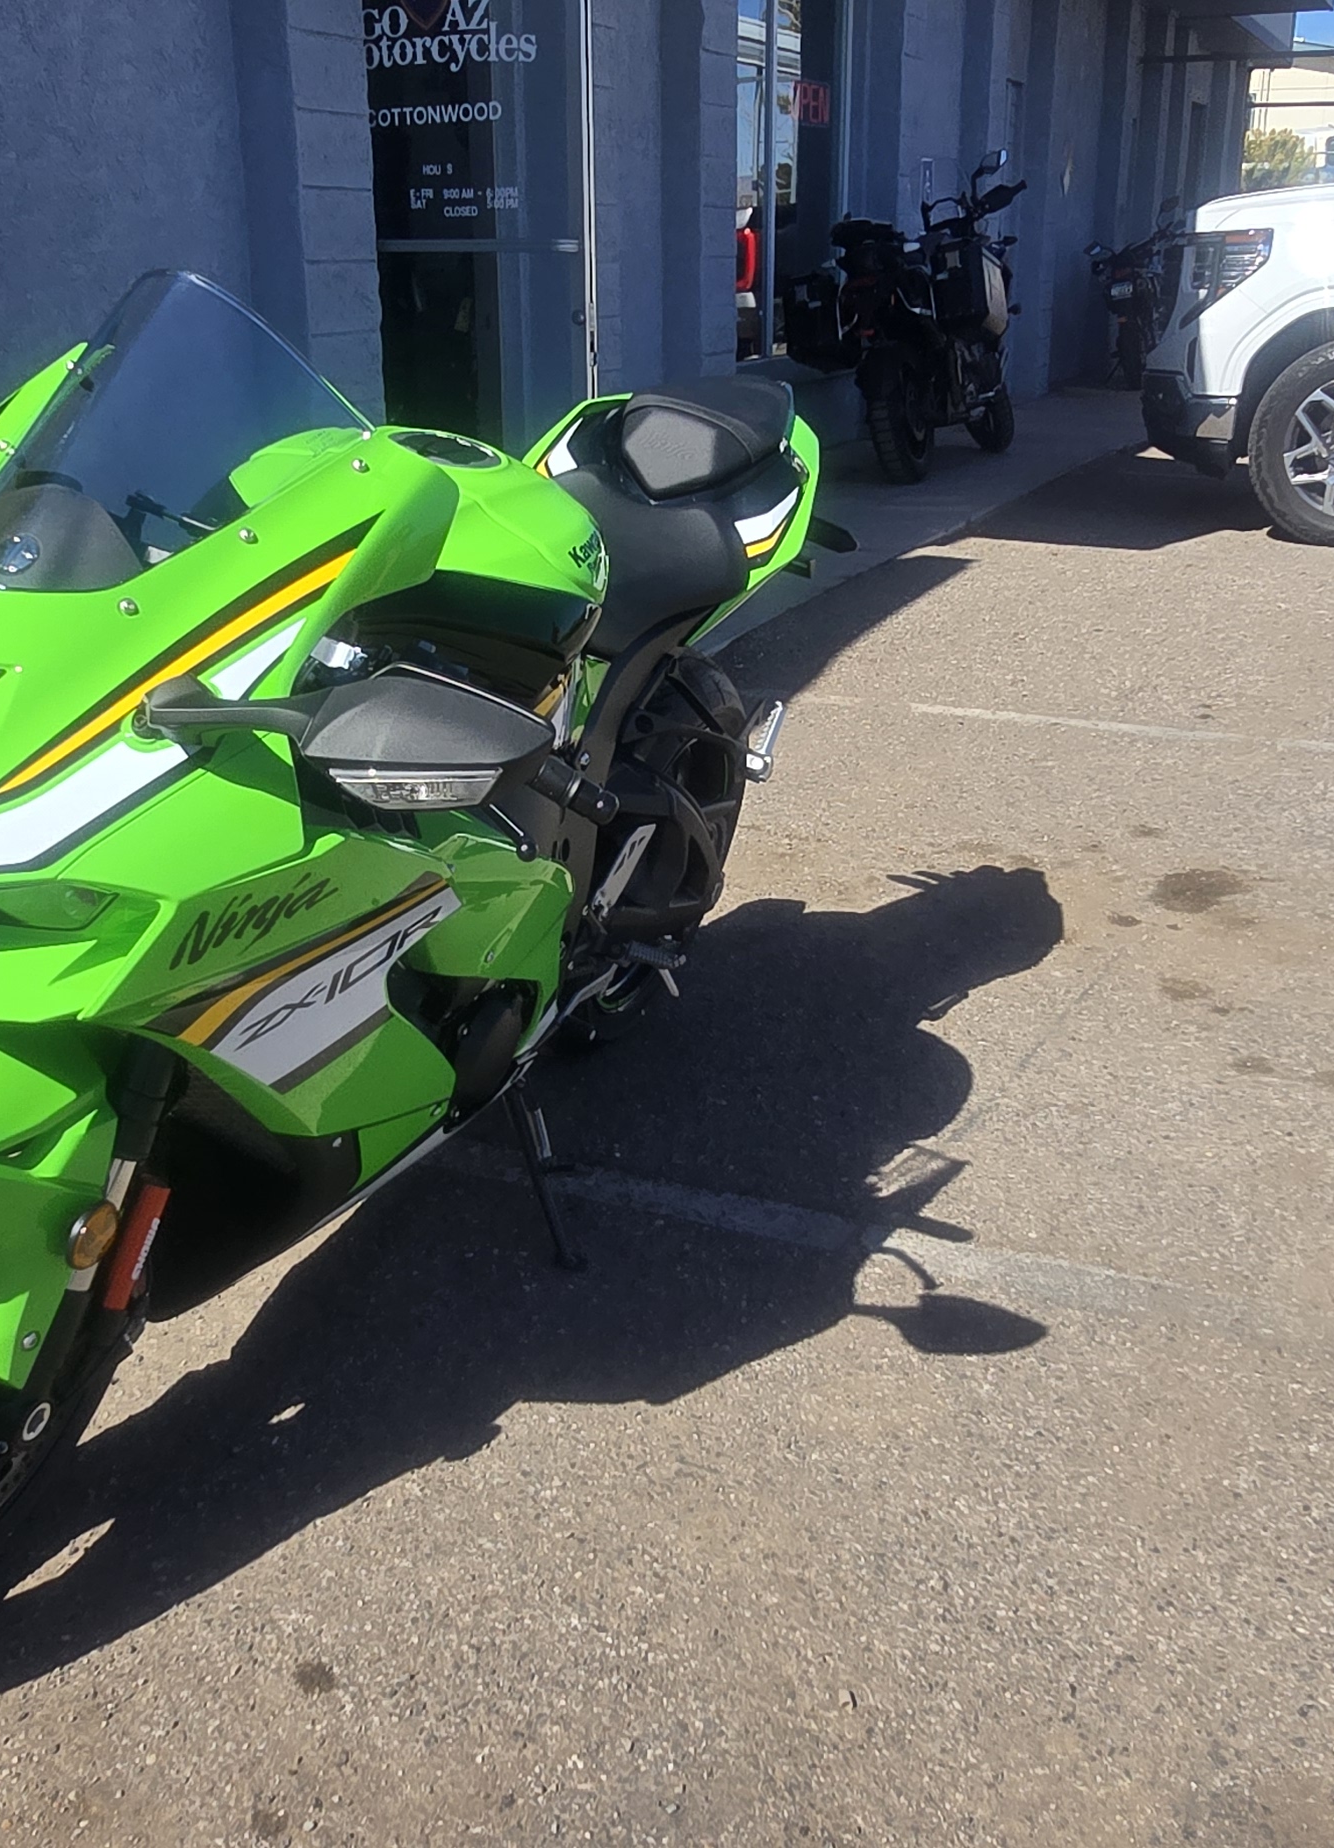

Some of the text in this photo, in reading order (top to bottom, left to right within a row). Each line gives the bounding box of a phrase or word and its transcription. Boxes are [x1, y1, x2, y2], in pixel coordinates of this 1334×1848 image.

[362, 0, 488, 40] GO AZ
[368, 101, 502, 128] COTTONWOOD
[443, 206, 479, 217] CLOSED
[169, 872, 339, 971] Ninja
[232, 905, 443, 1052] ZX-10R
